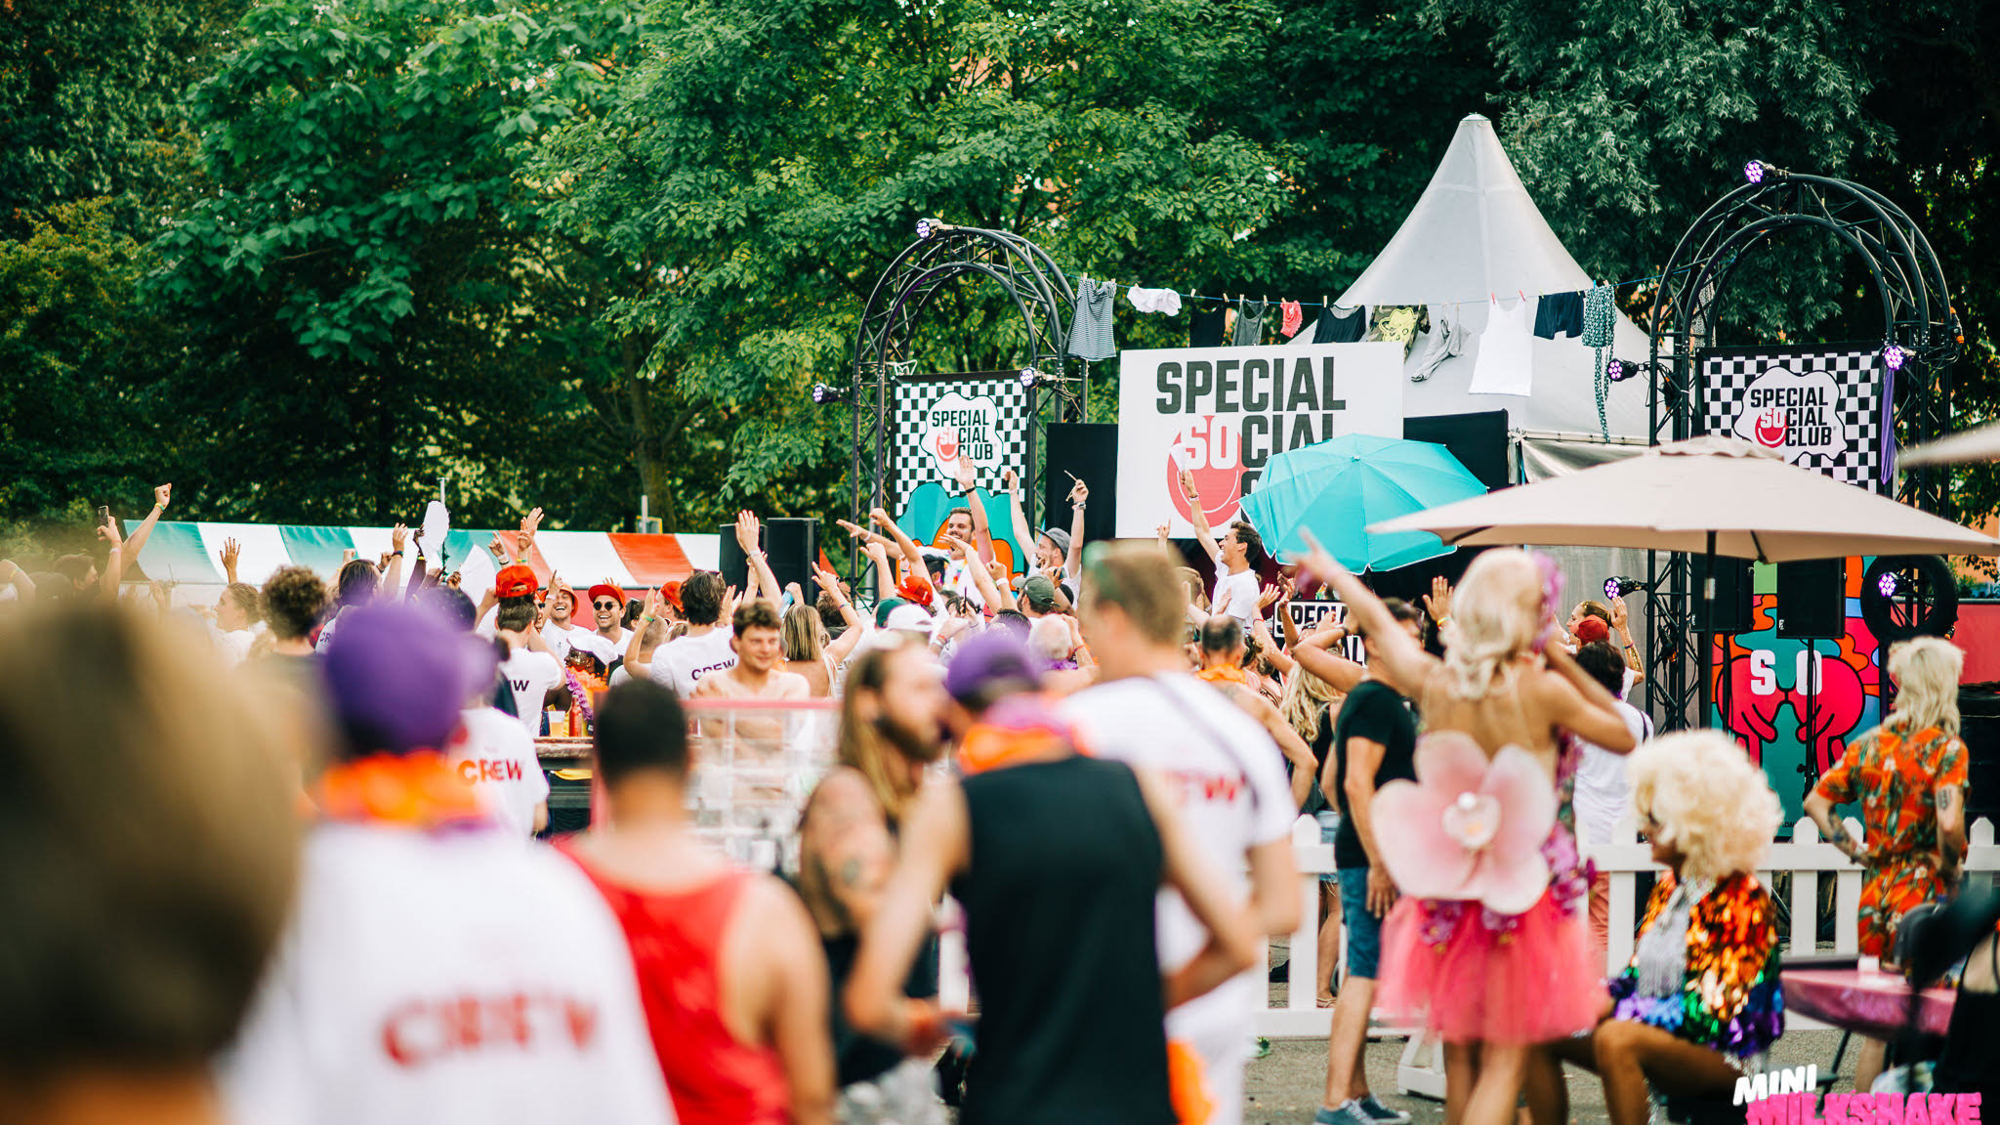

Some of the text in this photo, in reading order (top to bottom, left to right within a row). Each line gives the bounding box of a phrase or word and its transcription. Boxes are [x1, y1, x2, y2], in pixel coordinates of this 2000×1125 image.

[1156, 356, 1346, 414] SPECIAL
[1750, 386, 1829, 408] SPECIAL
[932, 409, 990, 427] SPECIAL
[1785, 426, 1832, 447] CLUB
[958, 443, 993, 460] CLUB
[457, 759, 523, 786] CREW
